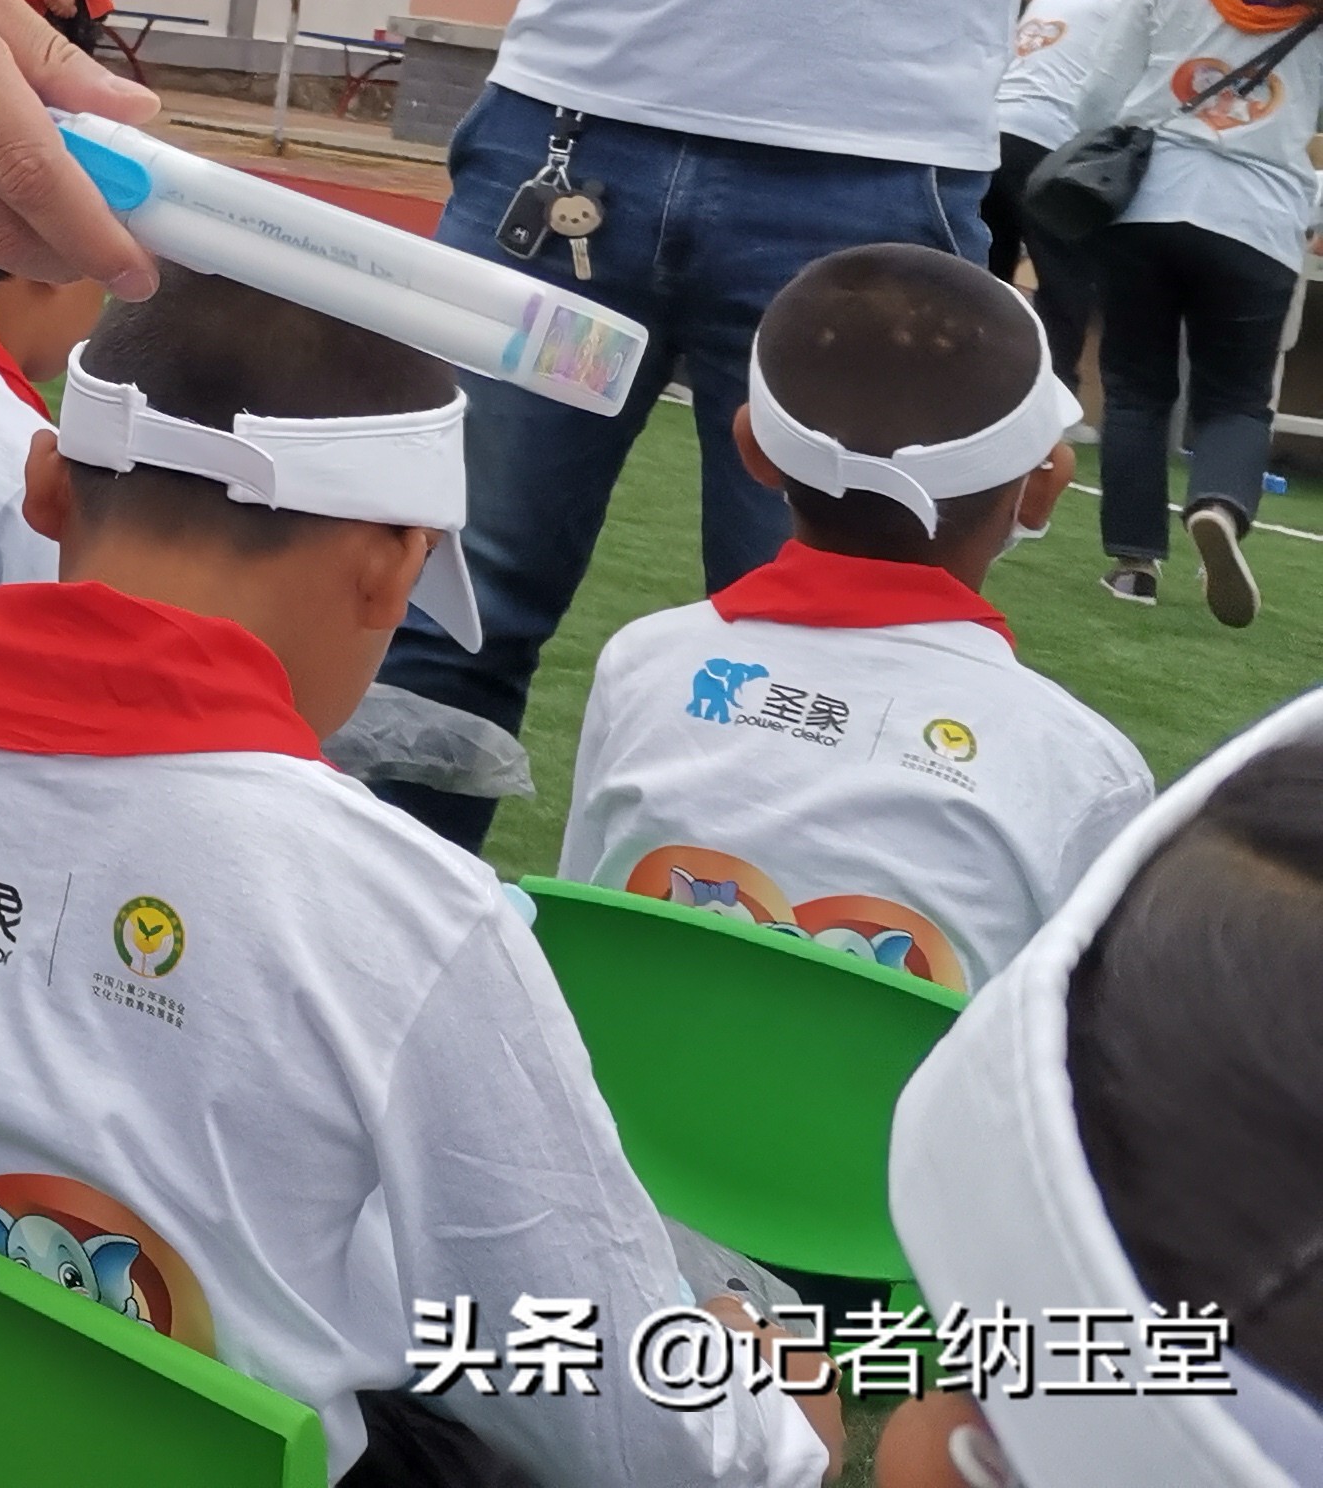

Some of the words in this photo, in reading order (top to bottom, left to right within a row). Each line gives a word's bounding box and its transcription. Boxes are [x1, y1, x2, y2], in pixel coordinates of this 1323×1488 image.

[760, 683, 850, 734] 圣象
[734, 714, 790, 732] power
[791, 727, 842, 748] dekor
